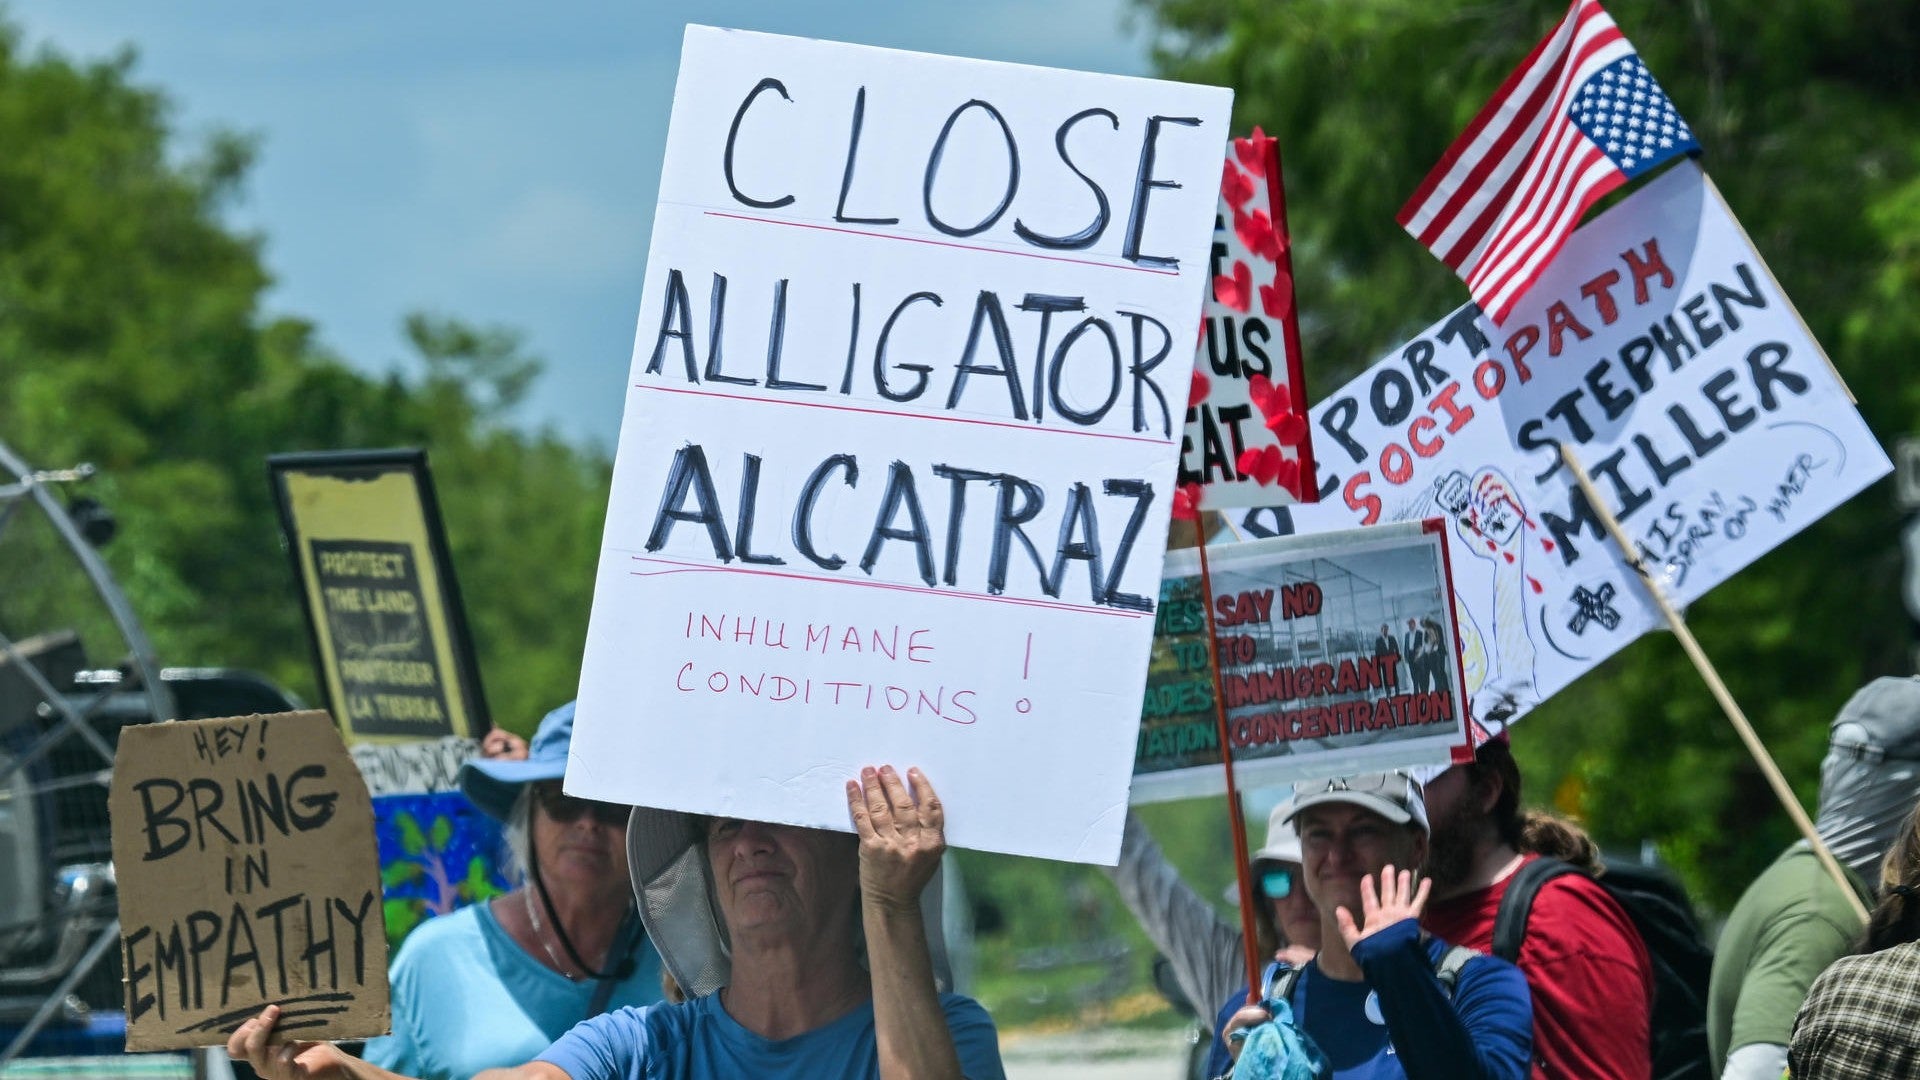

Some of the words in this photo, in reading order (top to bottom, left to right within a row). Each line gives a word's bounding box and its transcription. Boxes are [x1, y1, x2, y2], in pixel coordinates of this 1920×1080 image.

[724, 76, 1203, 268] CLOSE
[644, 268, 1172, 439] ALLIGATOR
[1343, 238, 1674, 526] SOCIOPATH
[1517, 263, 1768, 486] STEPHEN
[1540, 342, 1811, 567] MILLER
[644, 441, 1155, 613] ALCATRAZ
[1667, 489, 1725, 589] SPRAY
[1724, 495, 1758, 541] ON
[319, 551, 405, 579] PROTECT
[324, 586, 363, 613] THE
[366, 588, 418, 614] LAND
[1216, 589, 1274, 628] SAY
[1281, 581, 1323, 620] NO
[685, 611, 936, 664] INHUMANE
[1171, 641, 1208, 672] TO
[1219, 633, 1256, 666] TO
[677, 662, 978, 726] CONDITIONS
[1224, 653, 1401, 709] IMMIGRANT
[192, 718, 270, 766] HEY!
[1230, 690, 1453, 748] CONCENTRATION
[132, 764, 340, 863] BRING
[224, 849, 271, 896] IN
[124, 889, 375, 1026] EMPATHY
